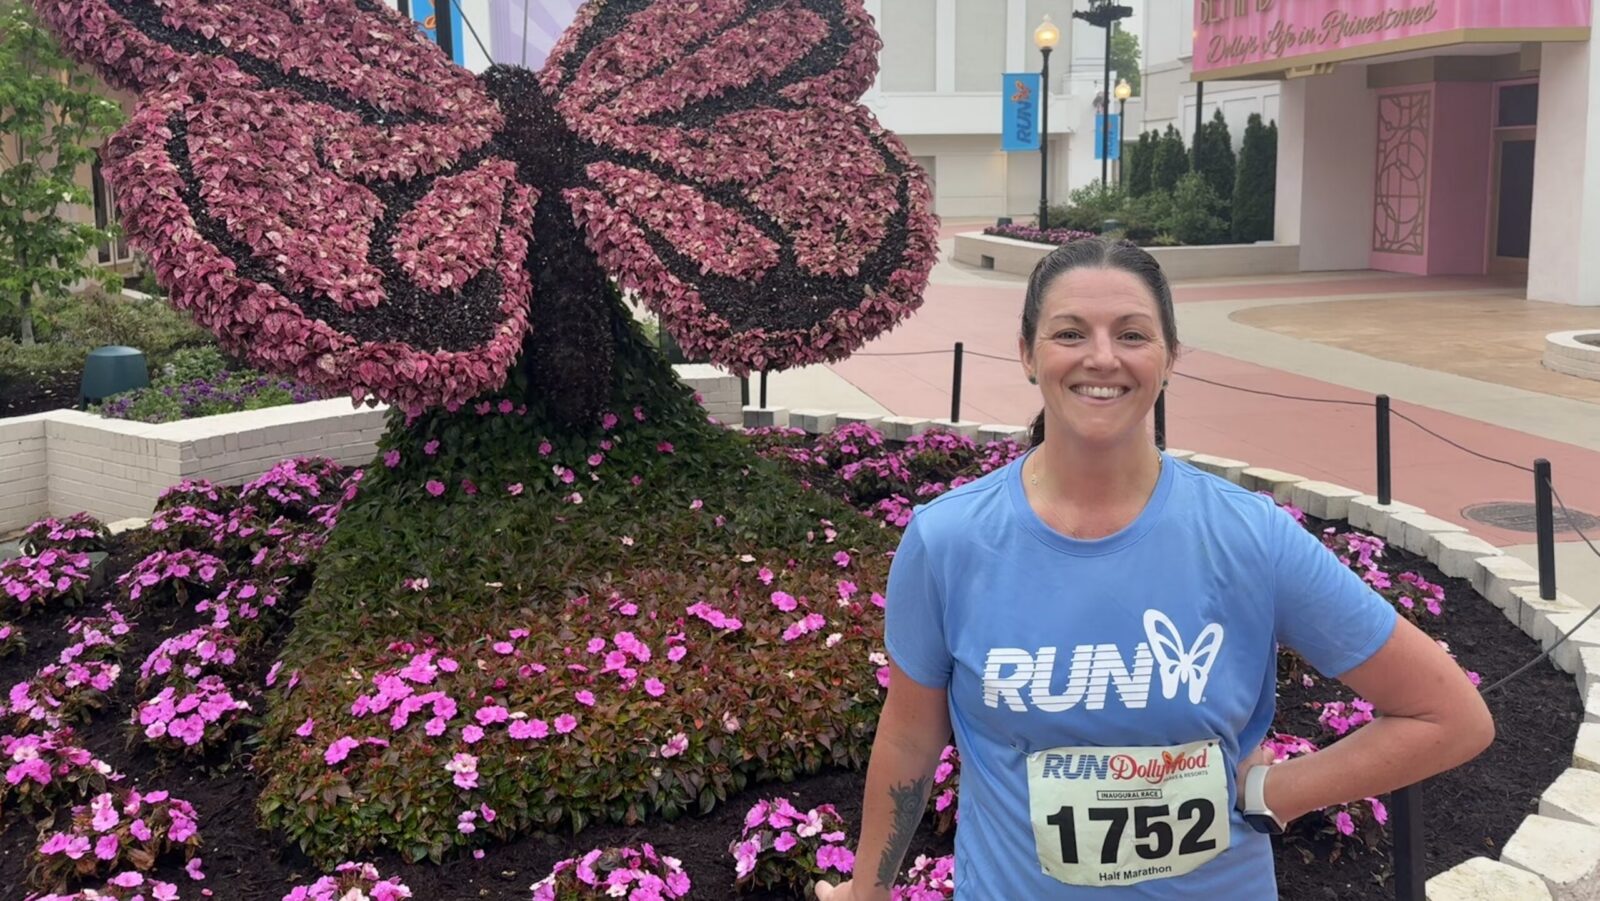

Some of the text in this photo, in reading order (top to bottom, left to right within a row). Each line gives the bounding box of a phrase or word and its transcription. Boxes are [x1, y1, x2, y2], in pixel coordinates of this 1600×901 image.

[1207, 34, 1259, 64] Dolly's
[1262, 19, 1297, 57] Life
[1298, 26, 1316, 47] in
[1016, 101, 1032, 144] RUN
[982, 642, 1155, 712] RUN
[1042, 753, 1110, 780] RUN
[1184, 770, 1209, 779] RESORTS
[1046, 798, 1217, 865] 1752
[1099, 864, 1172, 882] Half Marathon
